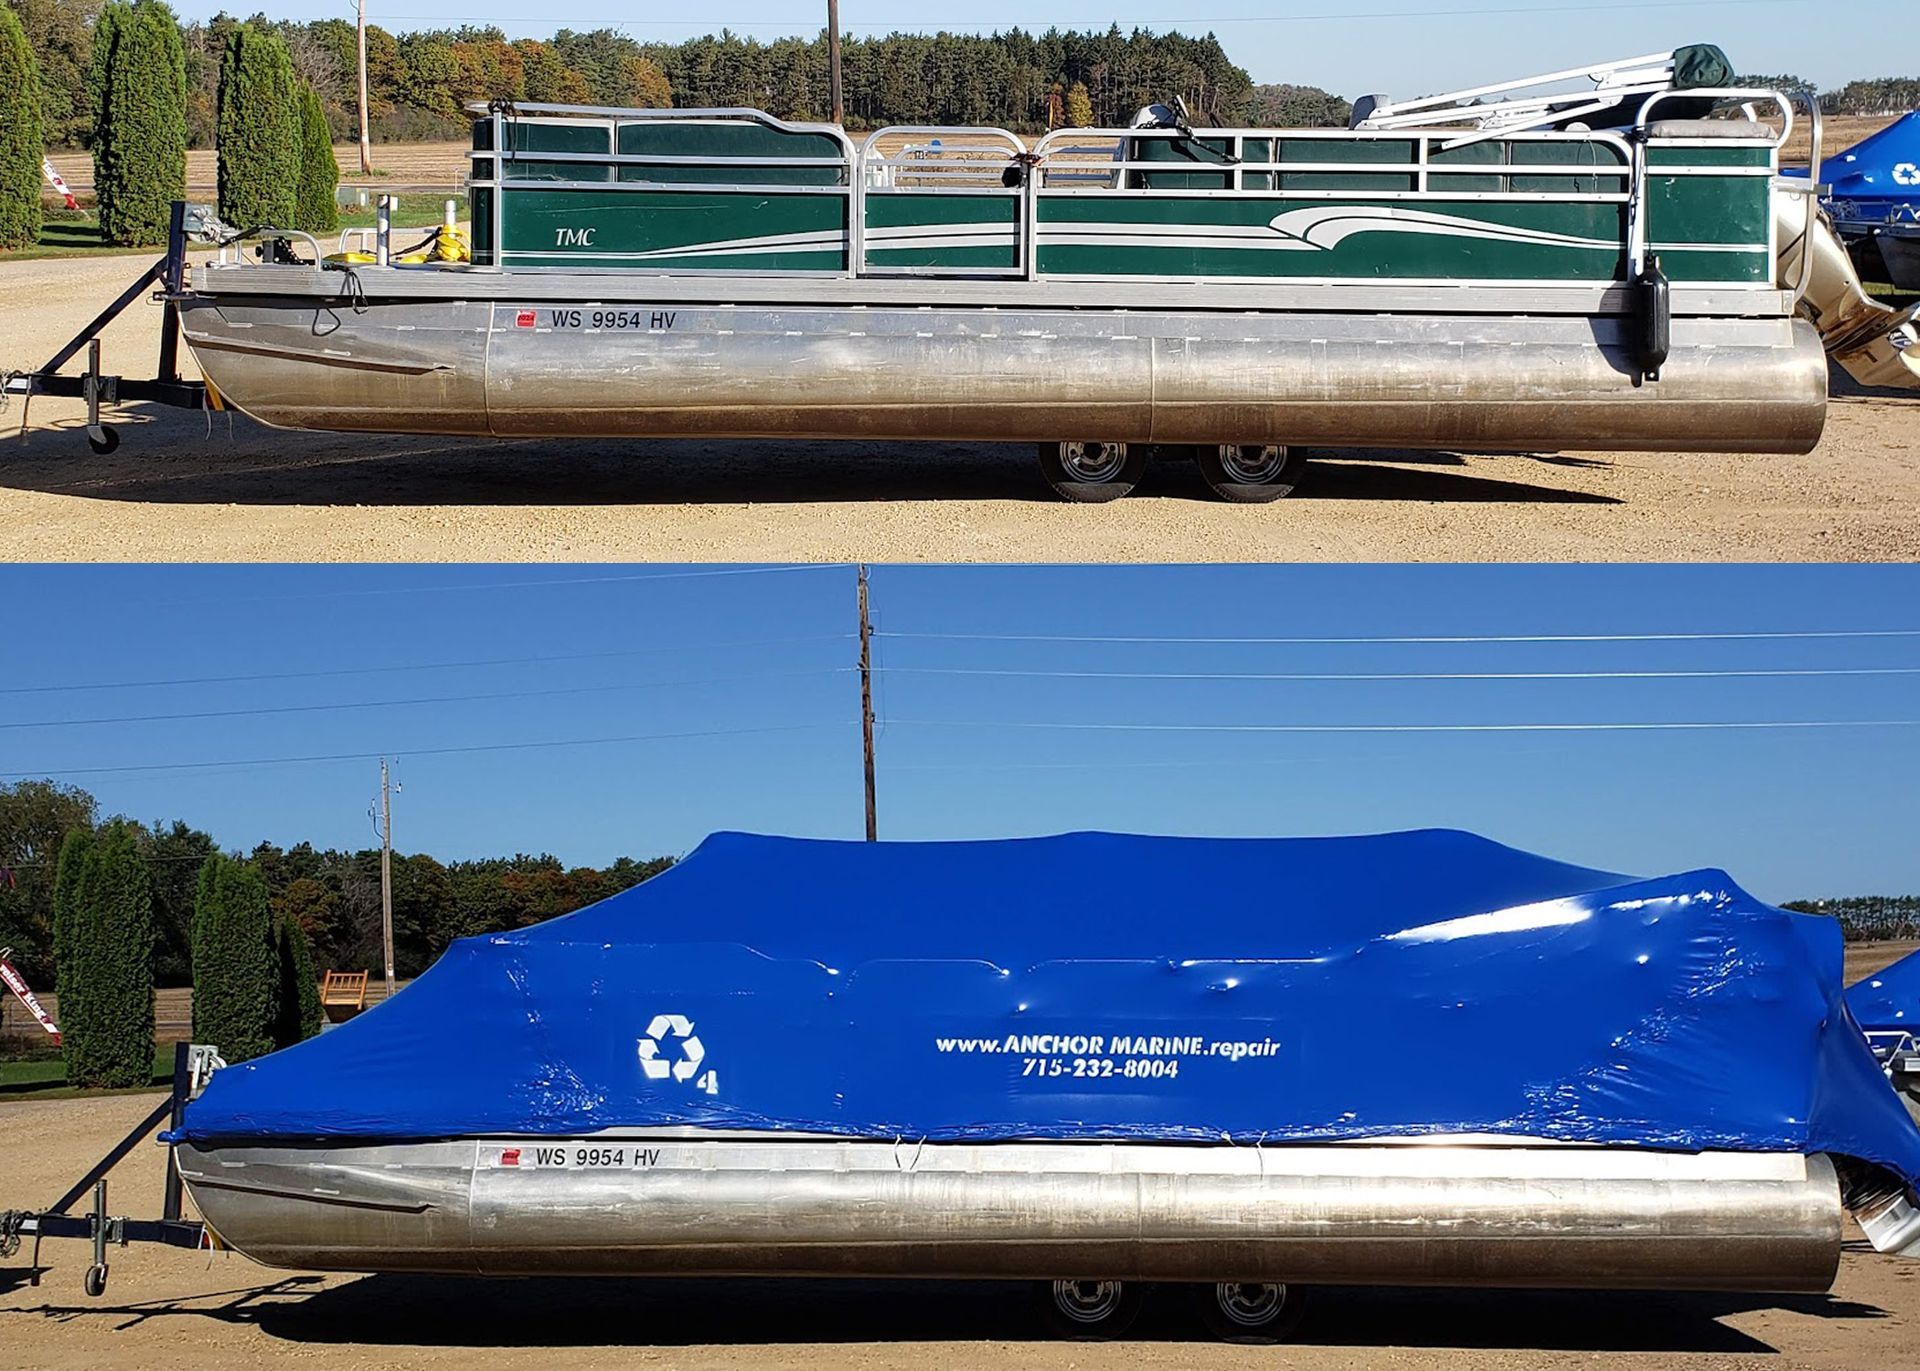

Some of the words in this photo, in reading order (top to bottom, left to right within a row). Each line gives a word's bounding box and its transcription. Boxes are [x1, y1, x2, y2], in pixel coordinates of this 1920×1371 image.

[555, 228, 596, 246] TMC
[552, 310, 582, 328] WS
[592, 311, 641, 329] 9954
[650, 311, 677, 329] HV
[936, 1034, 1104, 1054] www.ANCHOR
[1109, 1036, 1281, 1061] MARINE.repair
[1022, 1058, 1178, 1079] 715-232-8004
[696, 1070, 719, 1095] 4
[536, 1148, 566, 1166] WS
[576, 1148, 624, 1166] 9954
[634, 1149, 660, 1166] HV
